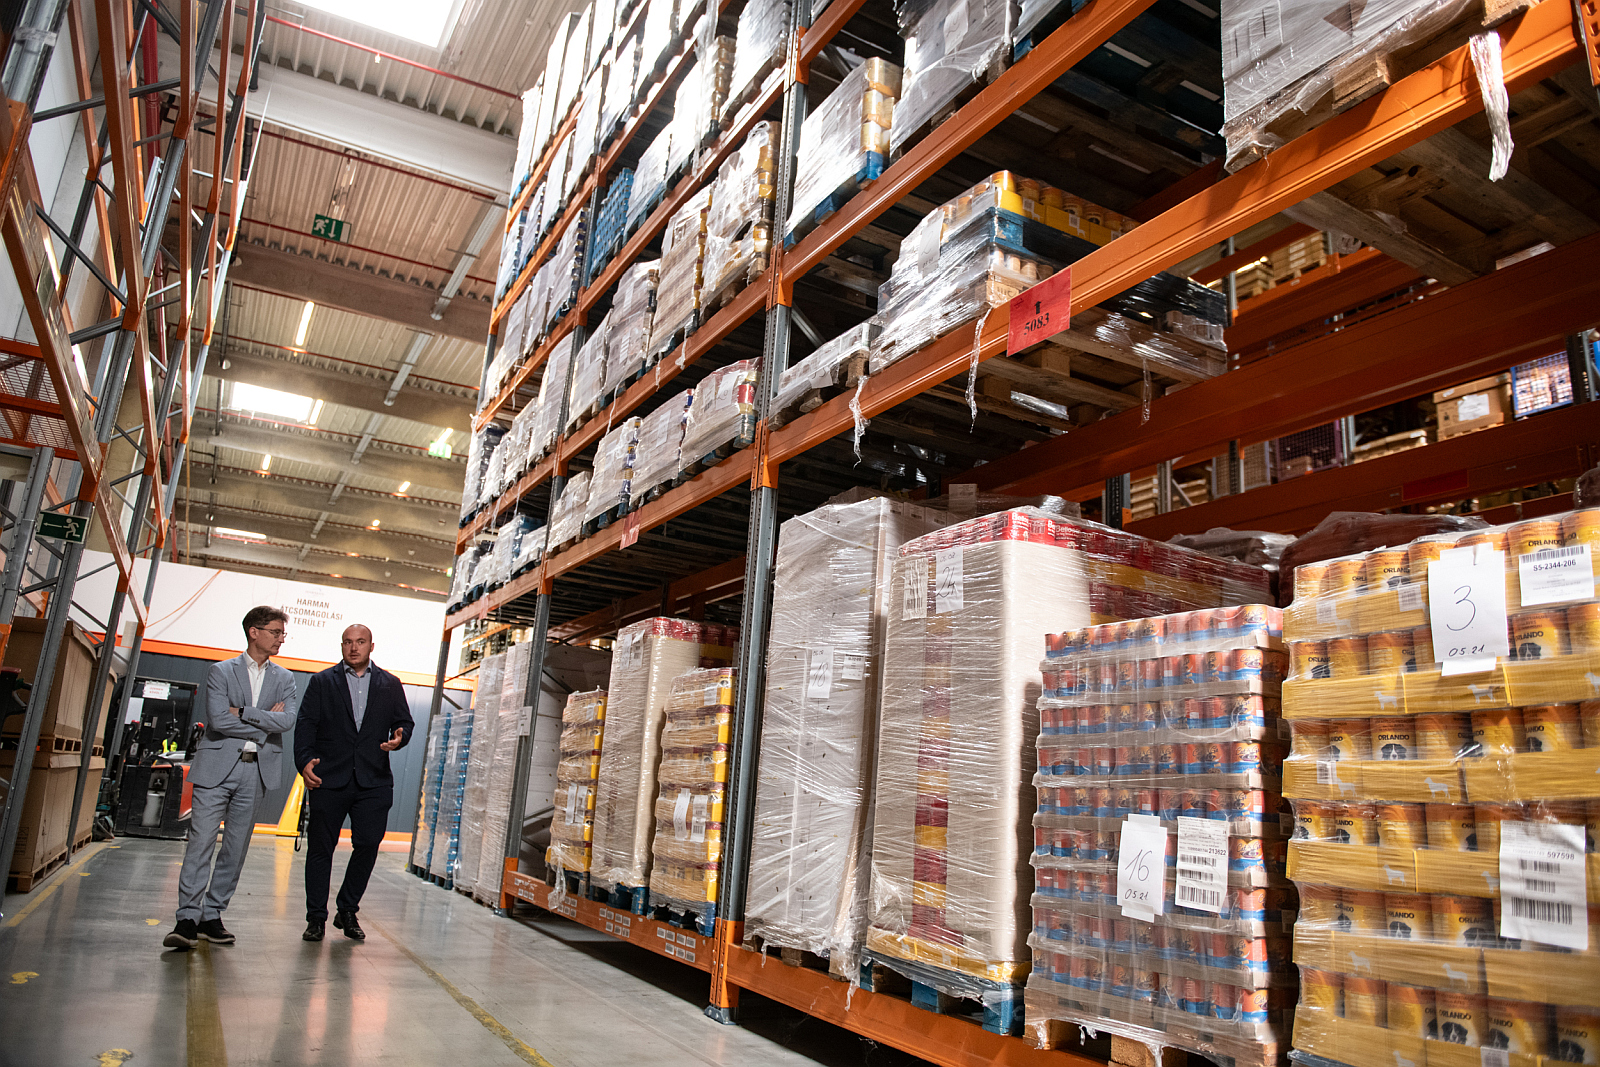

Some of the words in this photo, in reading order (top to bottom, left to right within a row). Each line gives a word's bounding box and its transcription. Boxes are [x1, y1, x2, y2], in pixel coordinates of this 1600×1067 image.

[1023, 312, 1050, 336] 5083
[297, 598, 330, 609] HARMAN
[293, 617, 326, 628] TERÜLET
[1547, 851, 1575, 860] 597598
[1125, 848, 1152, 881] 16
